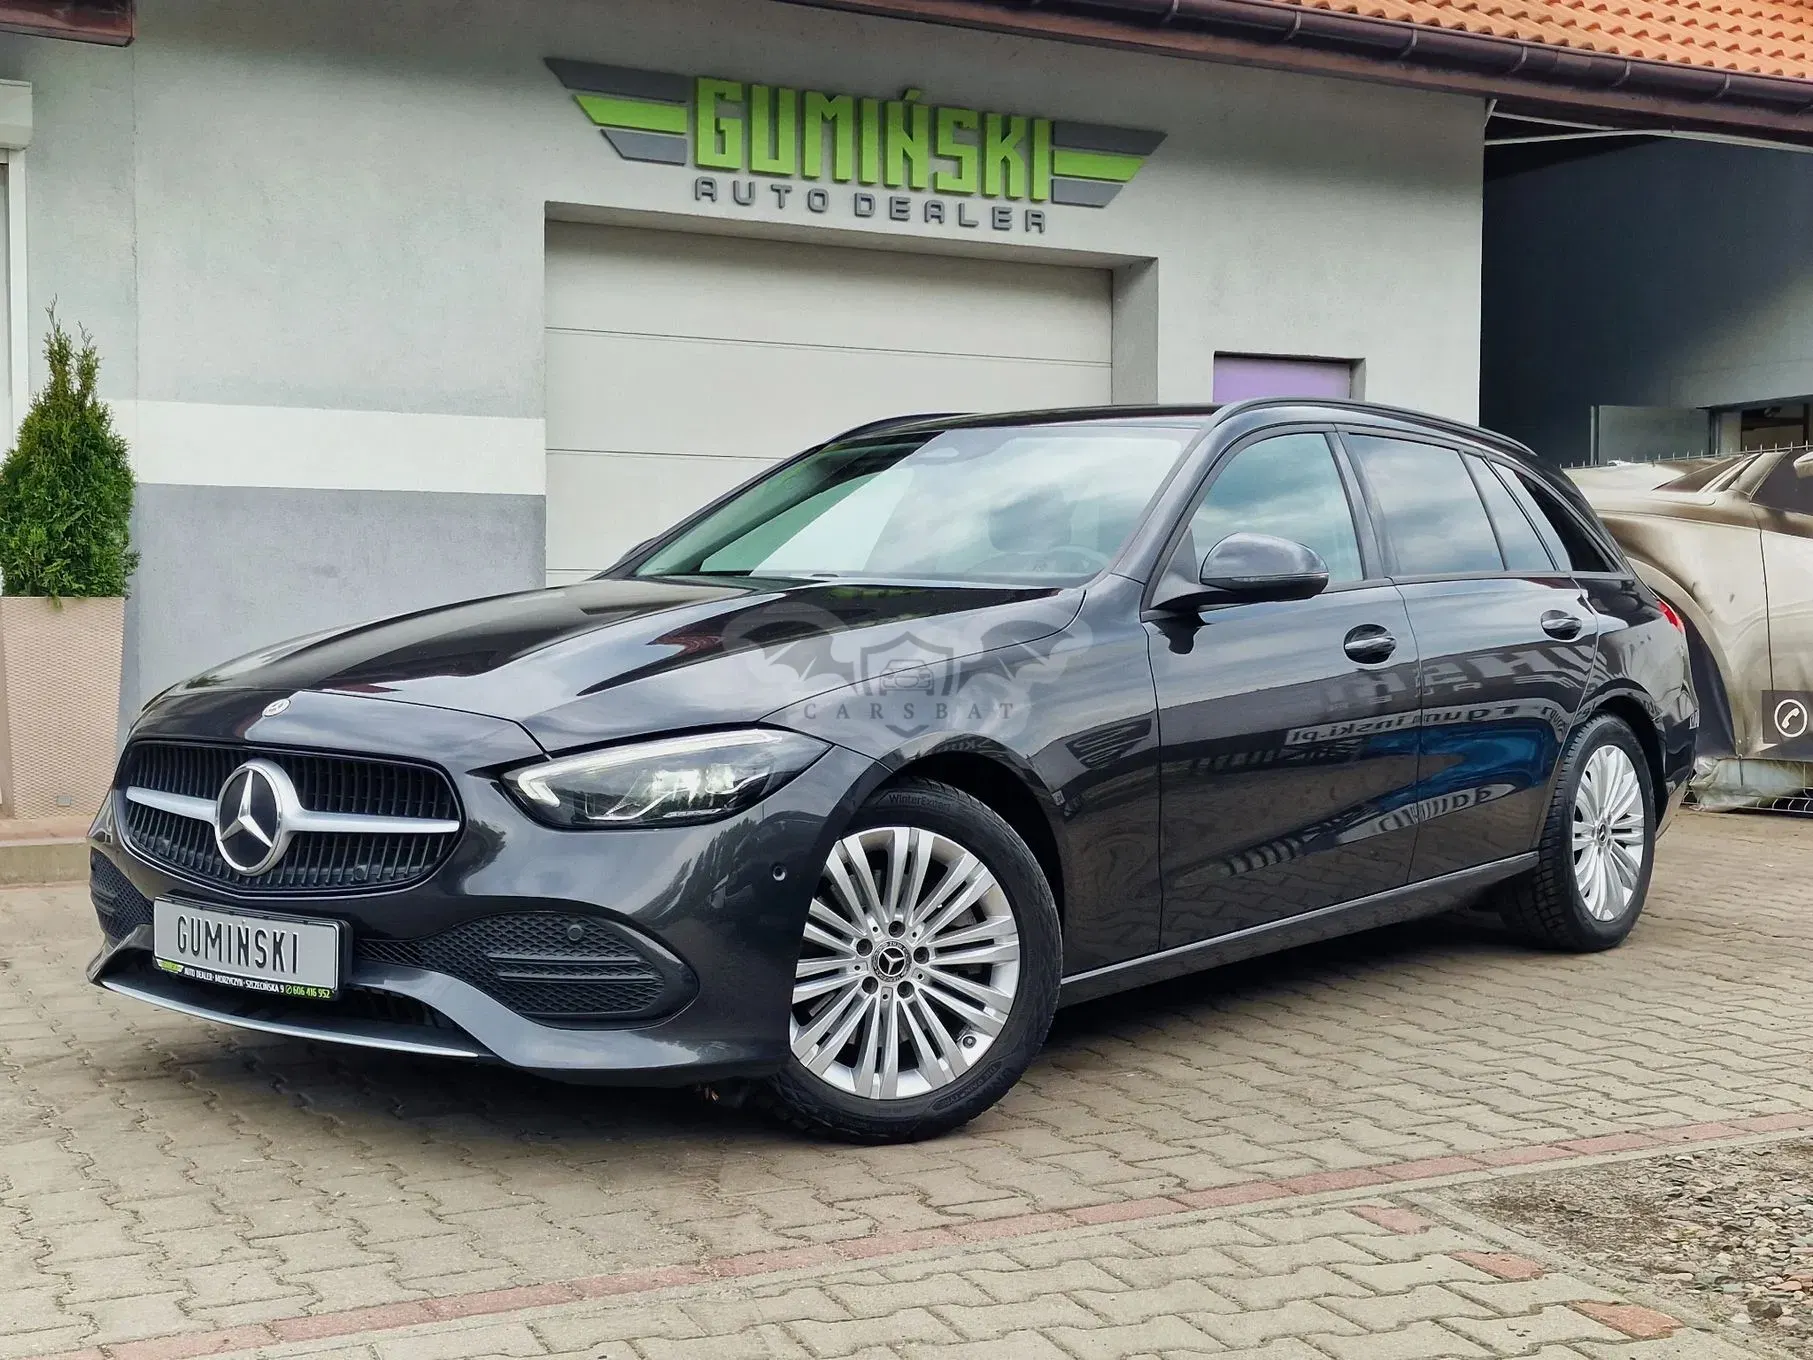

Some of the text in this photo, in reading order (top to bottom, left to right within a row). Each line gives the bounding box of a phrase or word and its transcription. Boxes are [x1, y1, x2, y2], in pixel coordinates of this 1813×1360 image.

[694, 76, 1052, 202] GUMIŃSKI
[694, 176, 1047, 234] AUTO DEALER
[292, 986, 305, 996] 606
[305, 988, 317, 997] 416
[318, 989, 330, 999] 952
